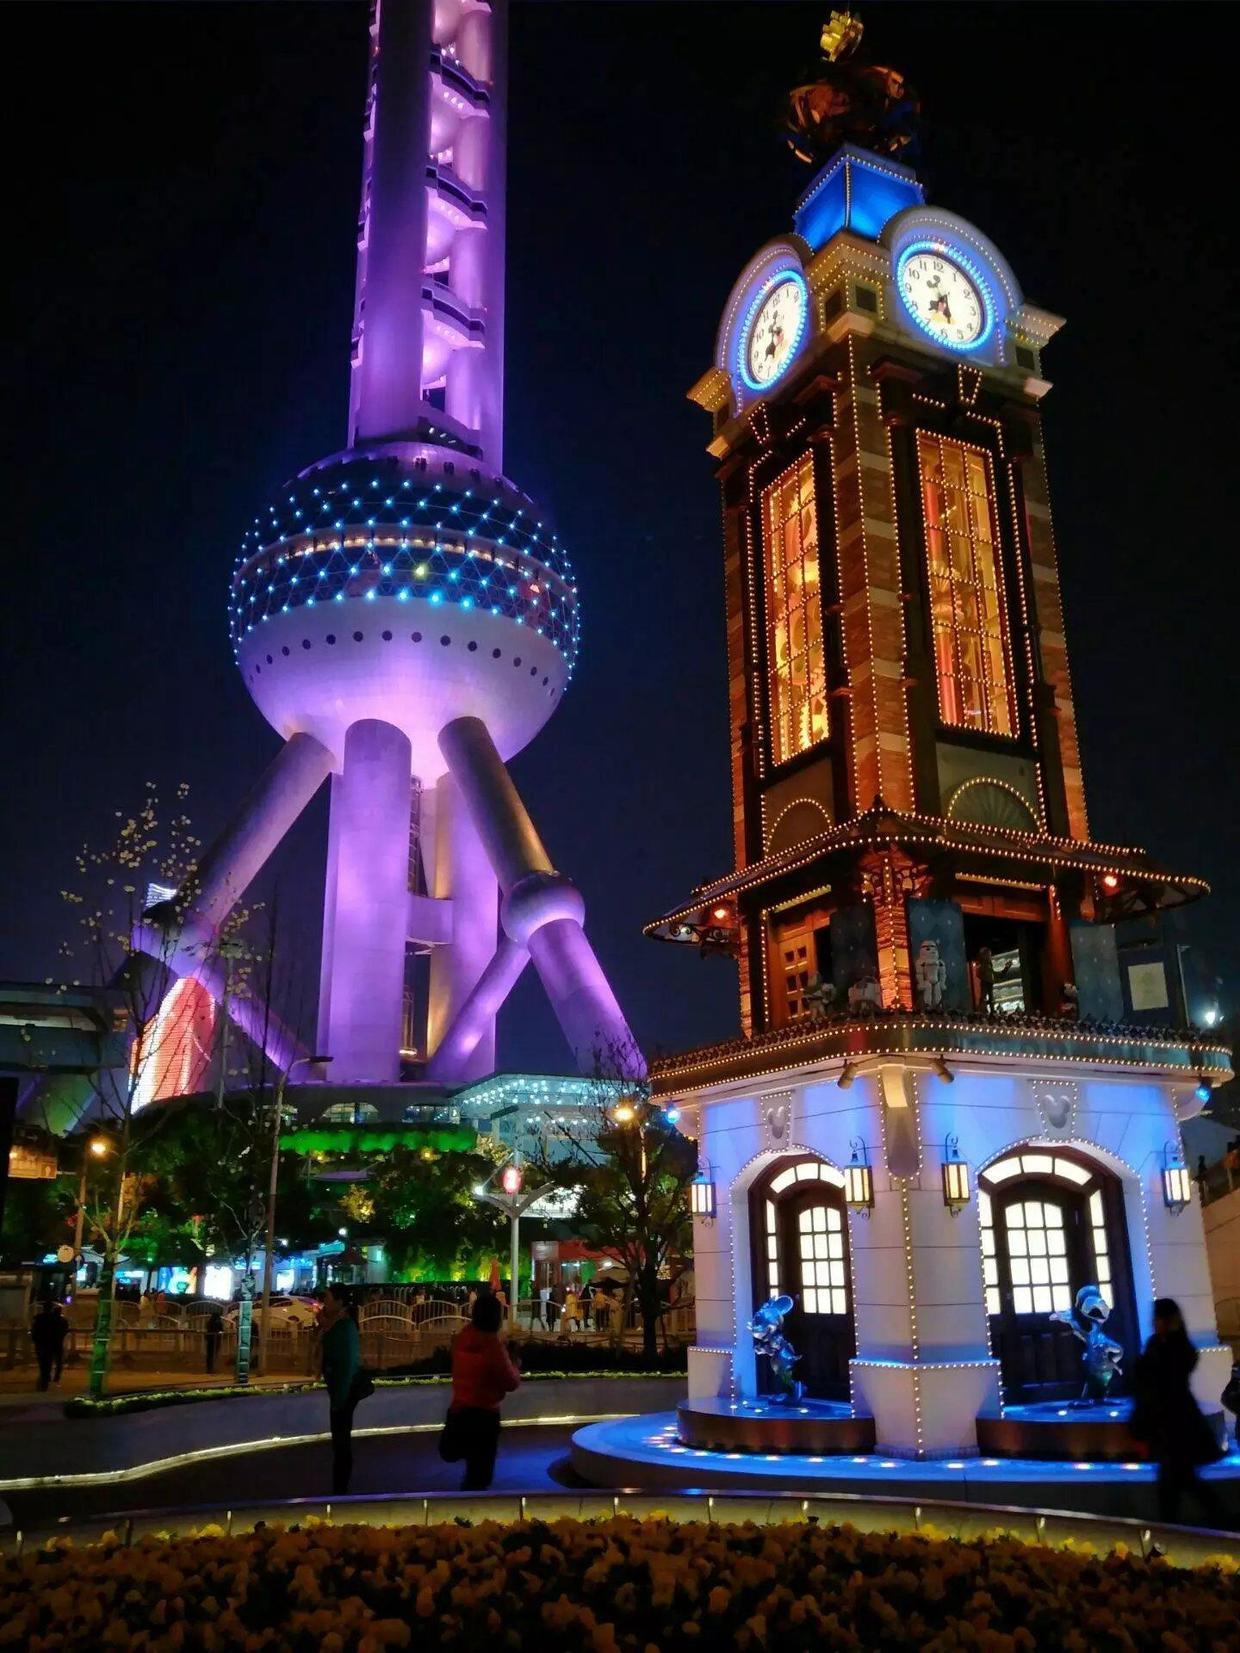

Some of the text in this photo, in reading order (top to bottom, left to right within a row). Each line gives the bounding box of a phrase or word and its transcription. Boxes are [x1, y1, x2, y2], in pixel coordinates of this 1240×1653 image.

[920, 260, 928, 271] 11
[933, 260, 945, 273] 12
[908, 267, 920, 280] 10
[952, 272, 957, 282] 1
[904, 282, 912, 293] 9
[963, 289, 973, 300] 2
[969, 305, 977, 317] 3
[966, 322, 974, 332] 4
[940, 328, 948, 339] 6
[956, 328, 964, 340] 5
